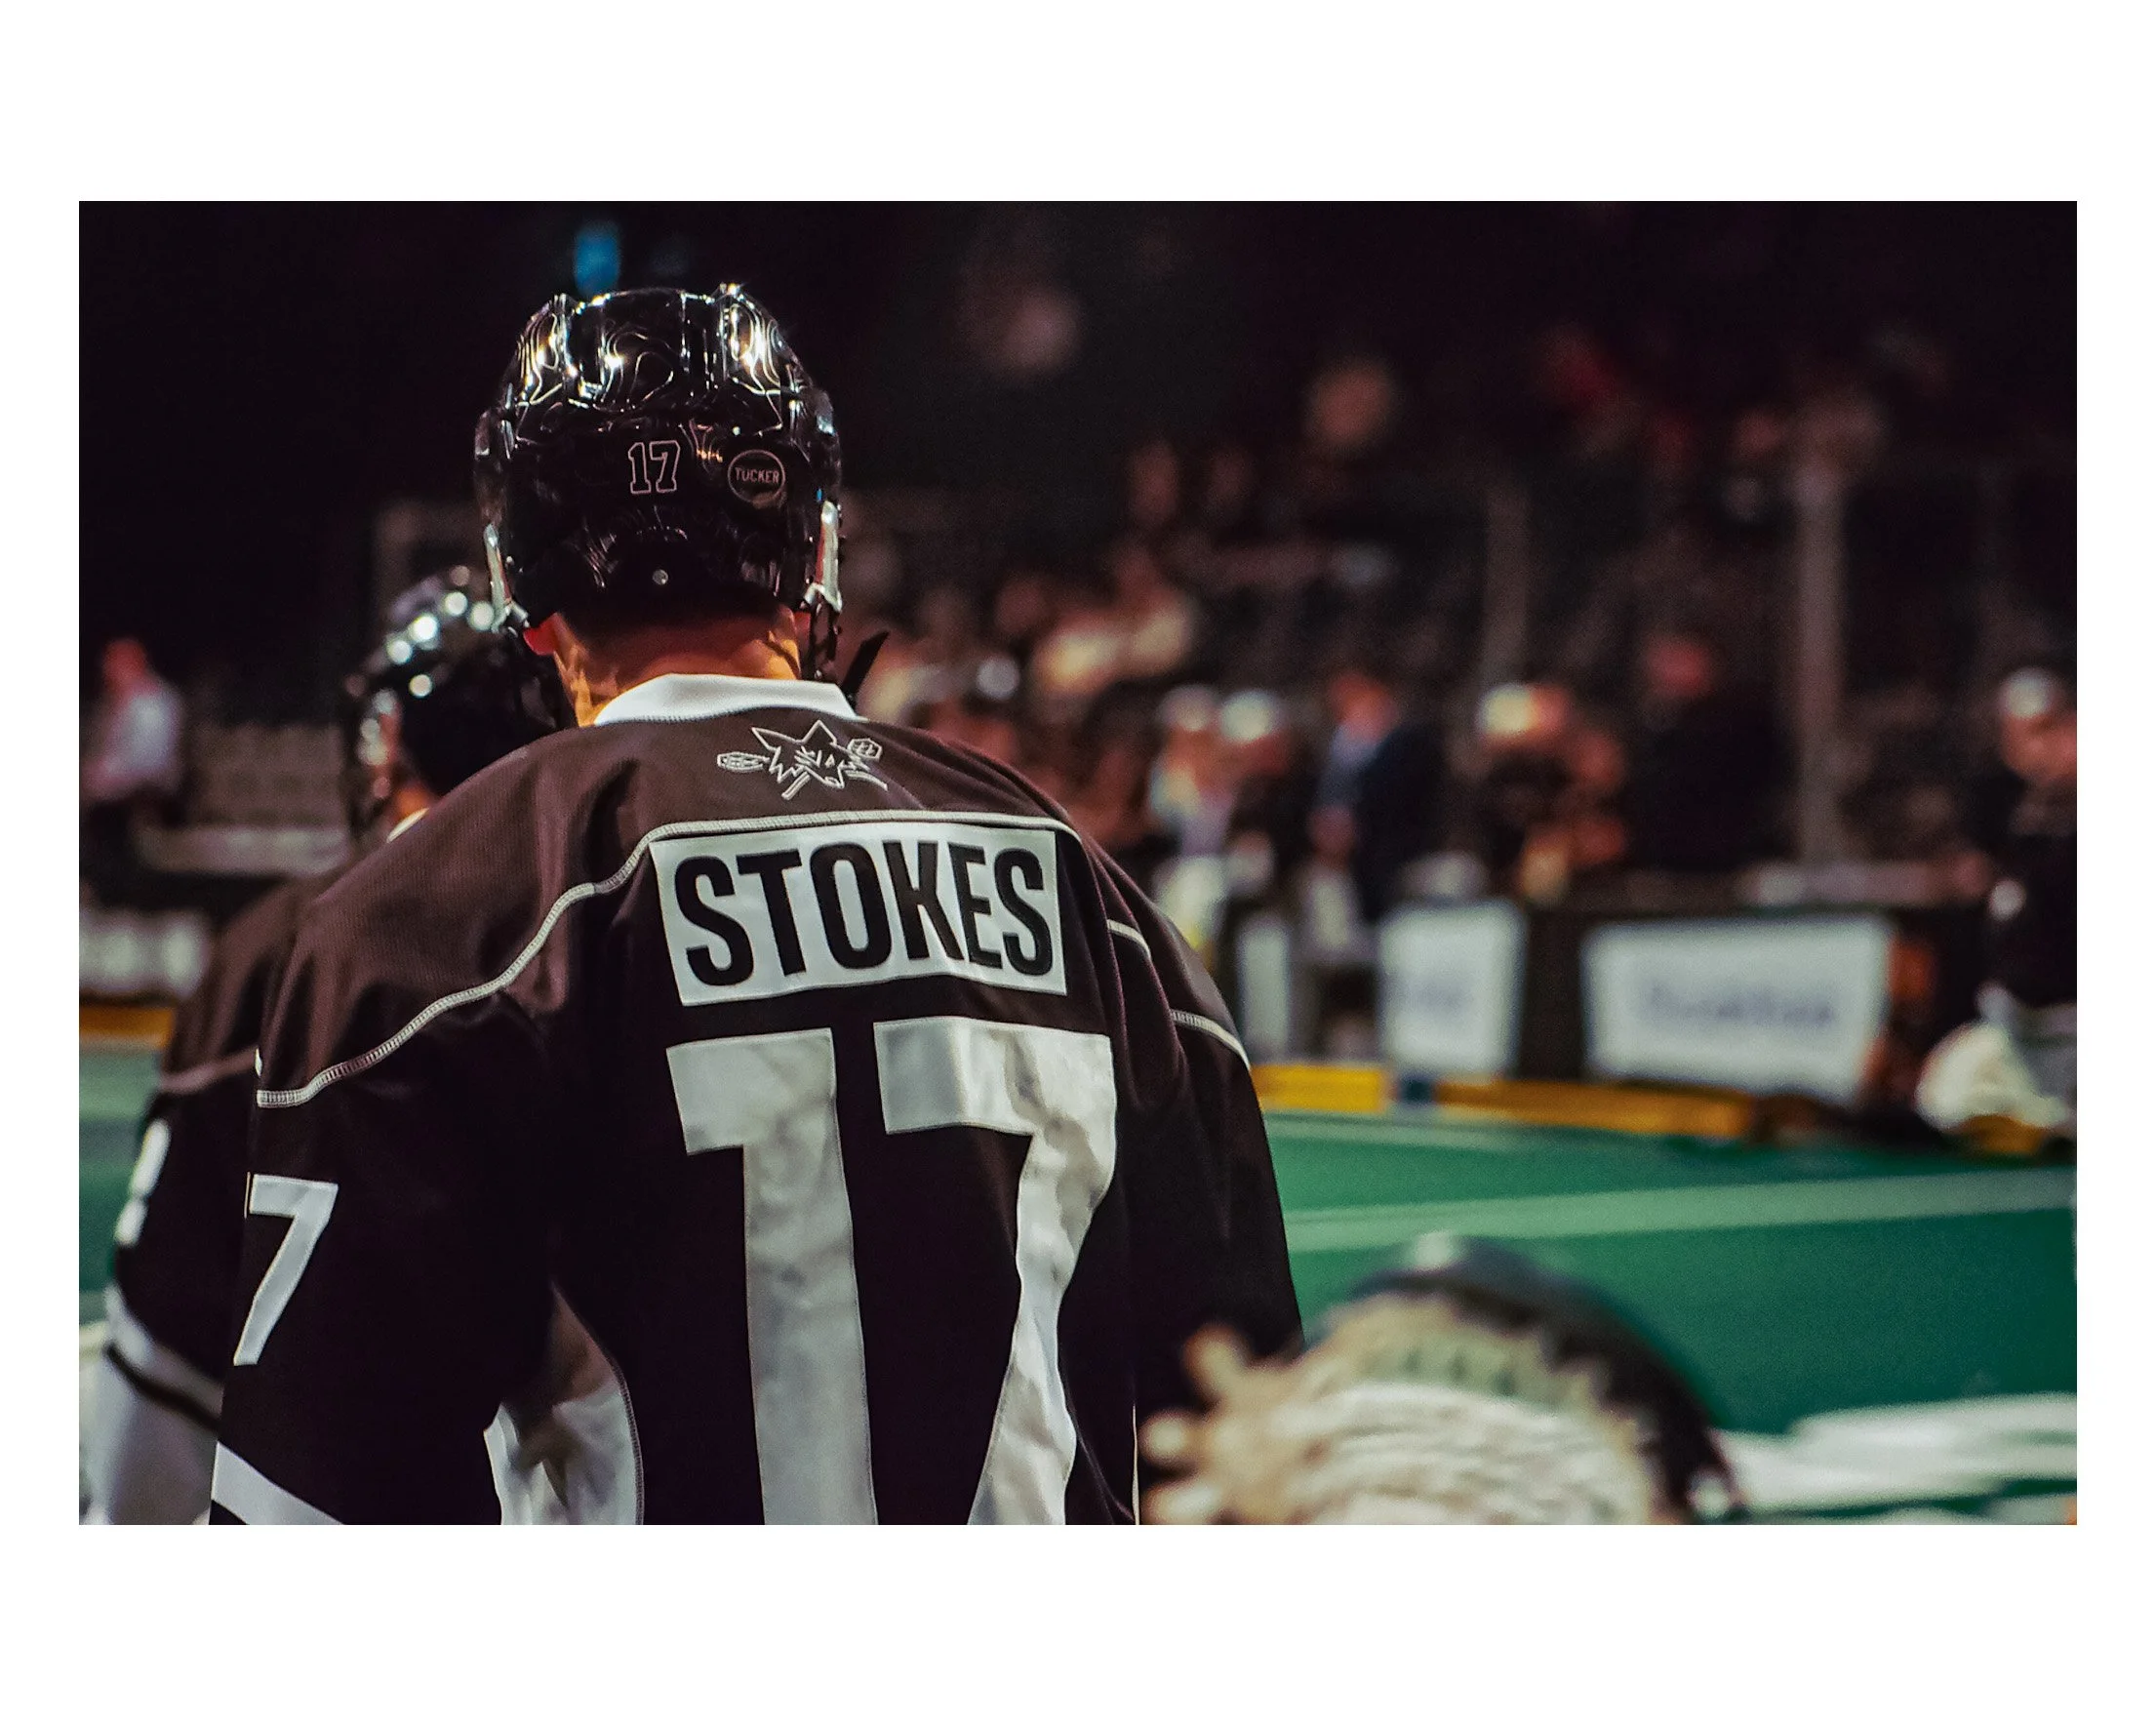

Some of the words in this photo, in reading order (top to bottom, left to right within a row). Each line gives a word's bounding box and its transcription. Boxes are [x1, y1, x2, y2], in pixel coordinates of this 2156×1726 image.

[627, 440, 681, 495] 17
[735, 466, 780, 484] TUCKER
[674, 840, 1054, 986] STOKES
[666, 1016, 1118, 1525] 17
